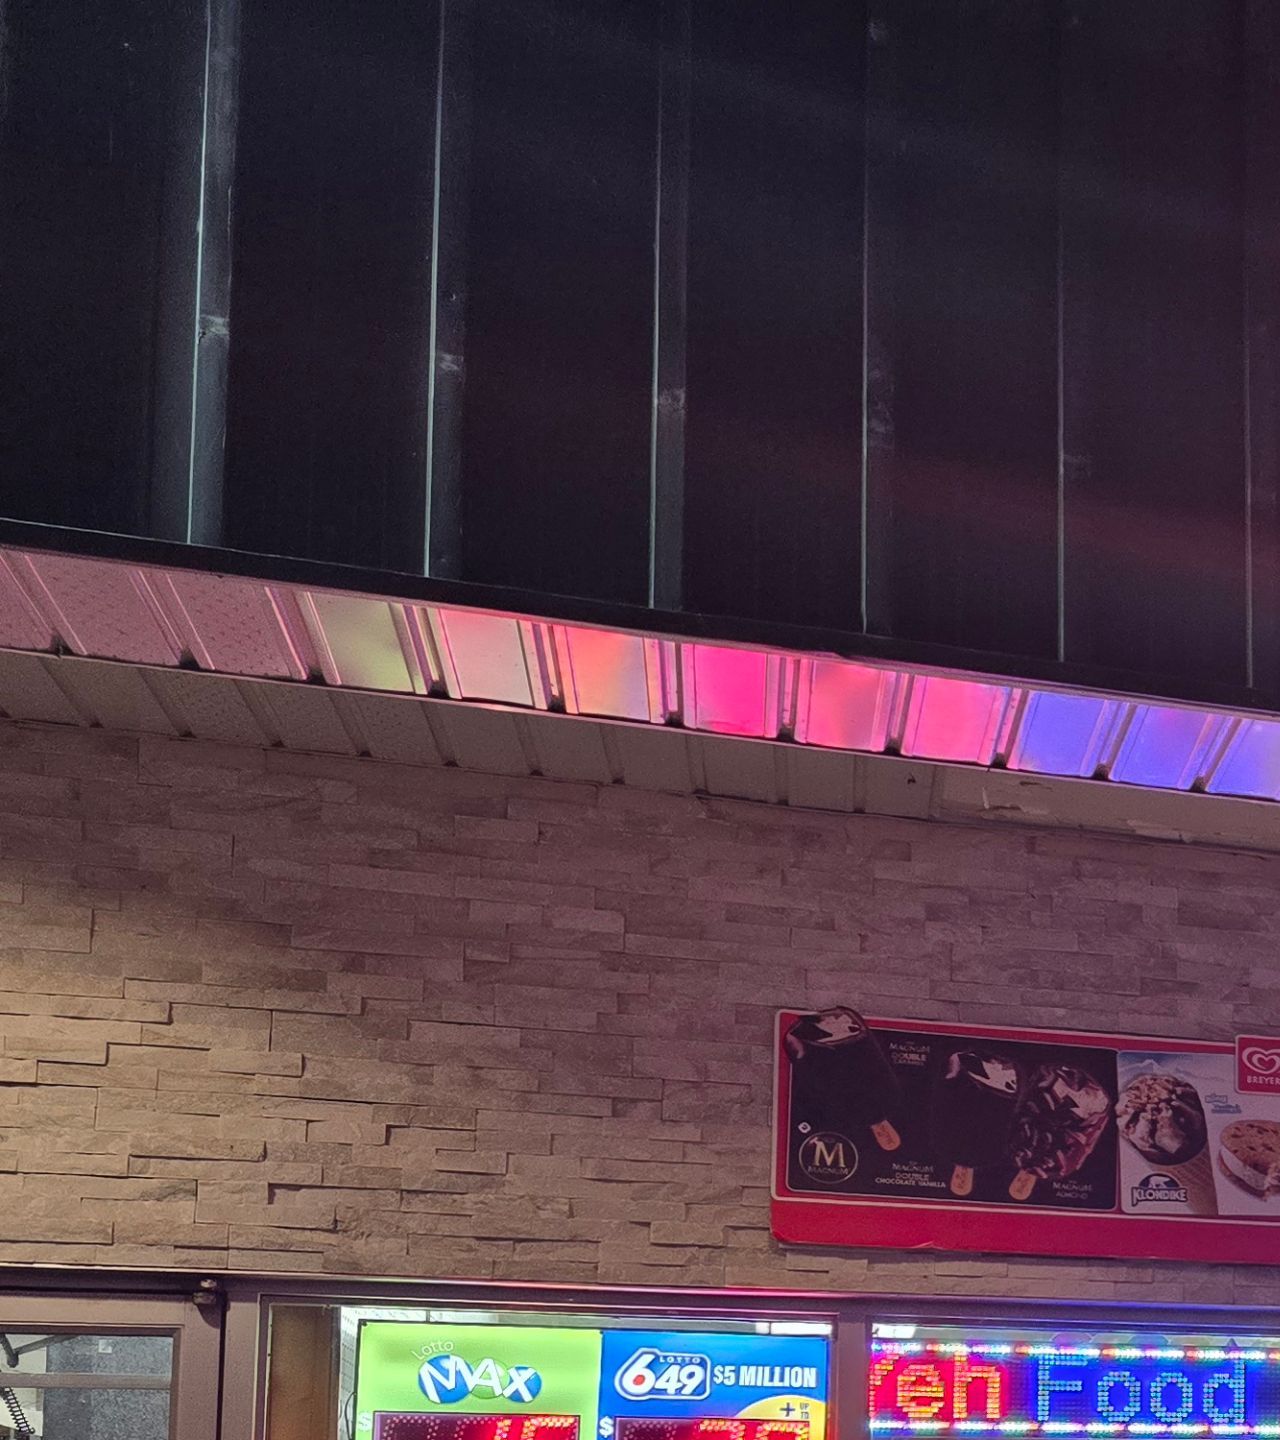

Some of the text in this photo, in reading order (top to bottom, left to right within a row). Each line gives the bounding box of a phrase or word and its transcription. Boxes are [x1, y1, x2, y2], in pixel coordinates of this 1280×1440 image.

[1131, 1187, 1188, 1207] KLONDIKE
[659, 1356, 701, 1364] LOTTO
[418, 1355, 540, 1403] MAX
[713, 1365, 736, 1386] $5
[739, 1365, 817, 1388] MILLION
[1037, 1352, 1248, 1424] Food
[599, 1416, 614, 1438] $
